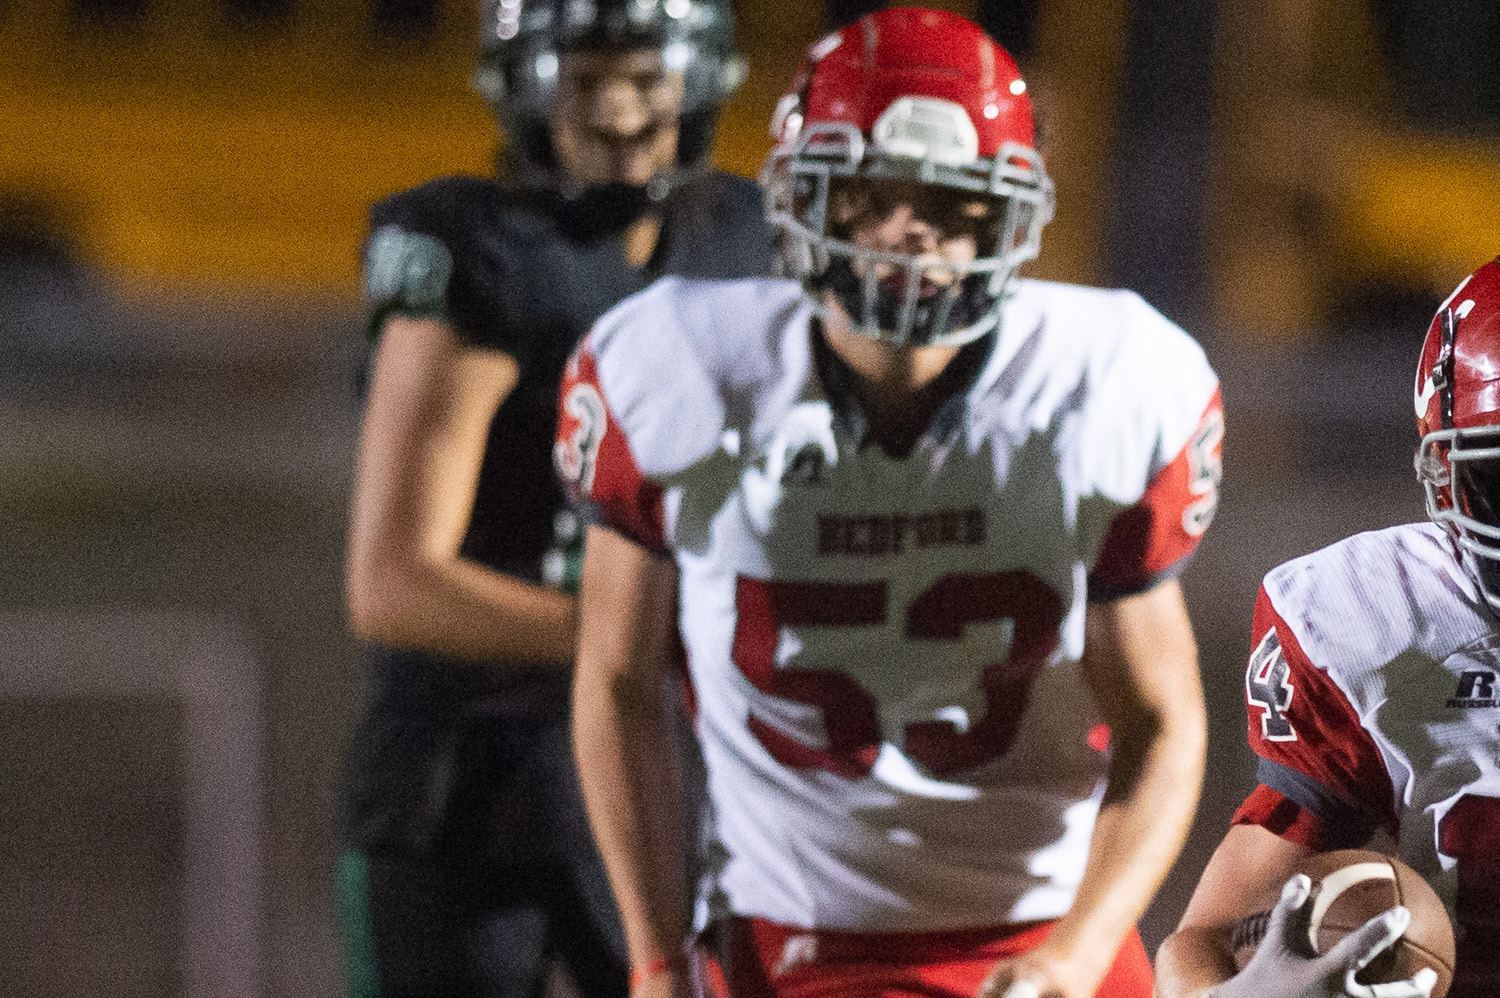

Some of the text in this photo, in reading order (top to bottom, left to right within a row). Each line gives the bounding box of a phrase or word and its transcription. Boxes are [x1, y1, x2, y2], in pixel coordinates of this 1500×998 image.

[816, 504, 987, 556] BEDFORD
[732, 569, 1065, 782] 53
[1456, 671, 1497, 698] R
